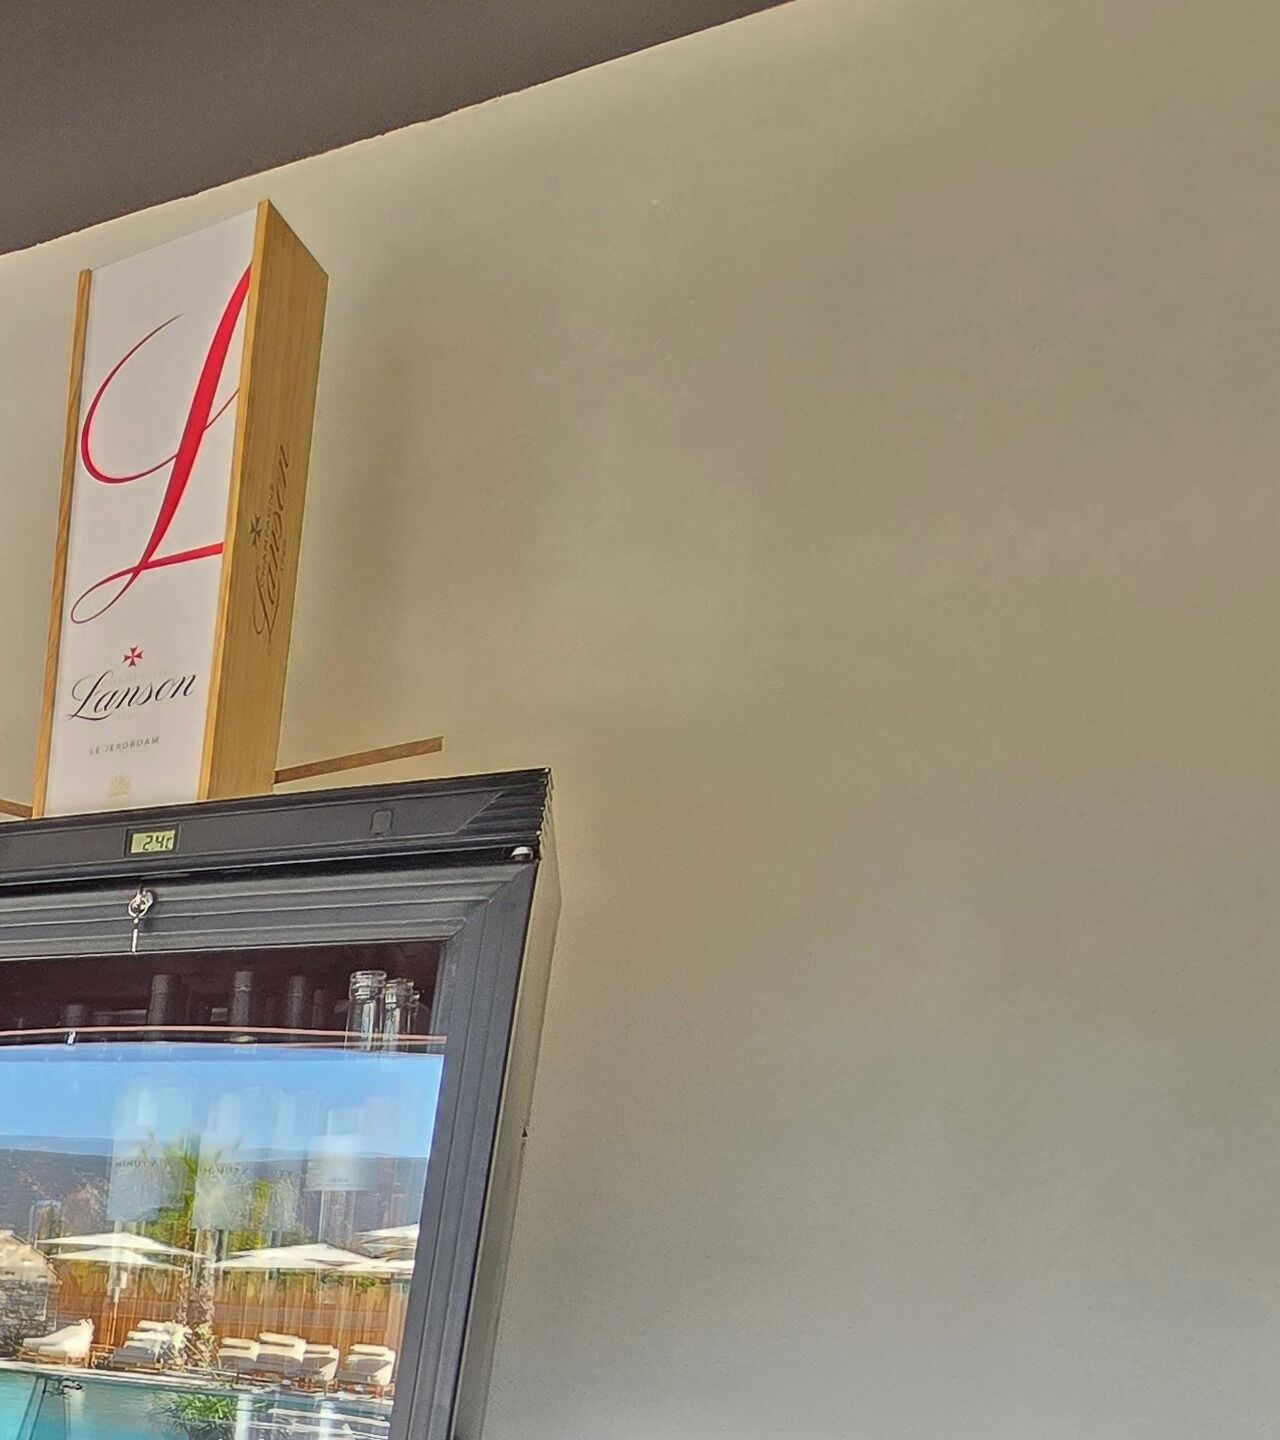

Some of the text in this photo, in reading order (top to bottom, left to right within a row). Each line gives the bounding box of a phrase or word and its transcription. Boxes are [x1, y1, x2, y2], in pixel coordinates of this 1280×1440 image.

[65, 670, 196, 721] Lanson
[90, 736, 160, 755] LE JEROBOAM
